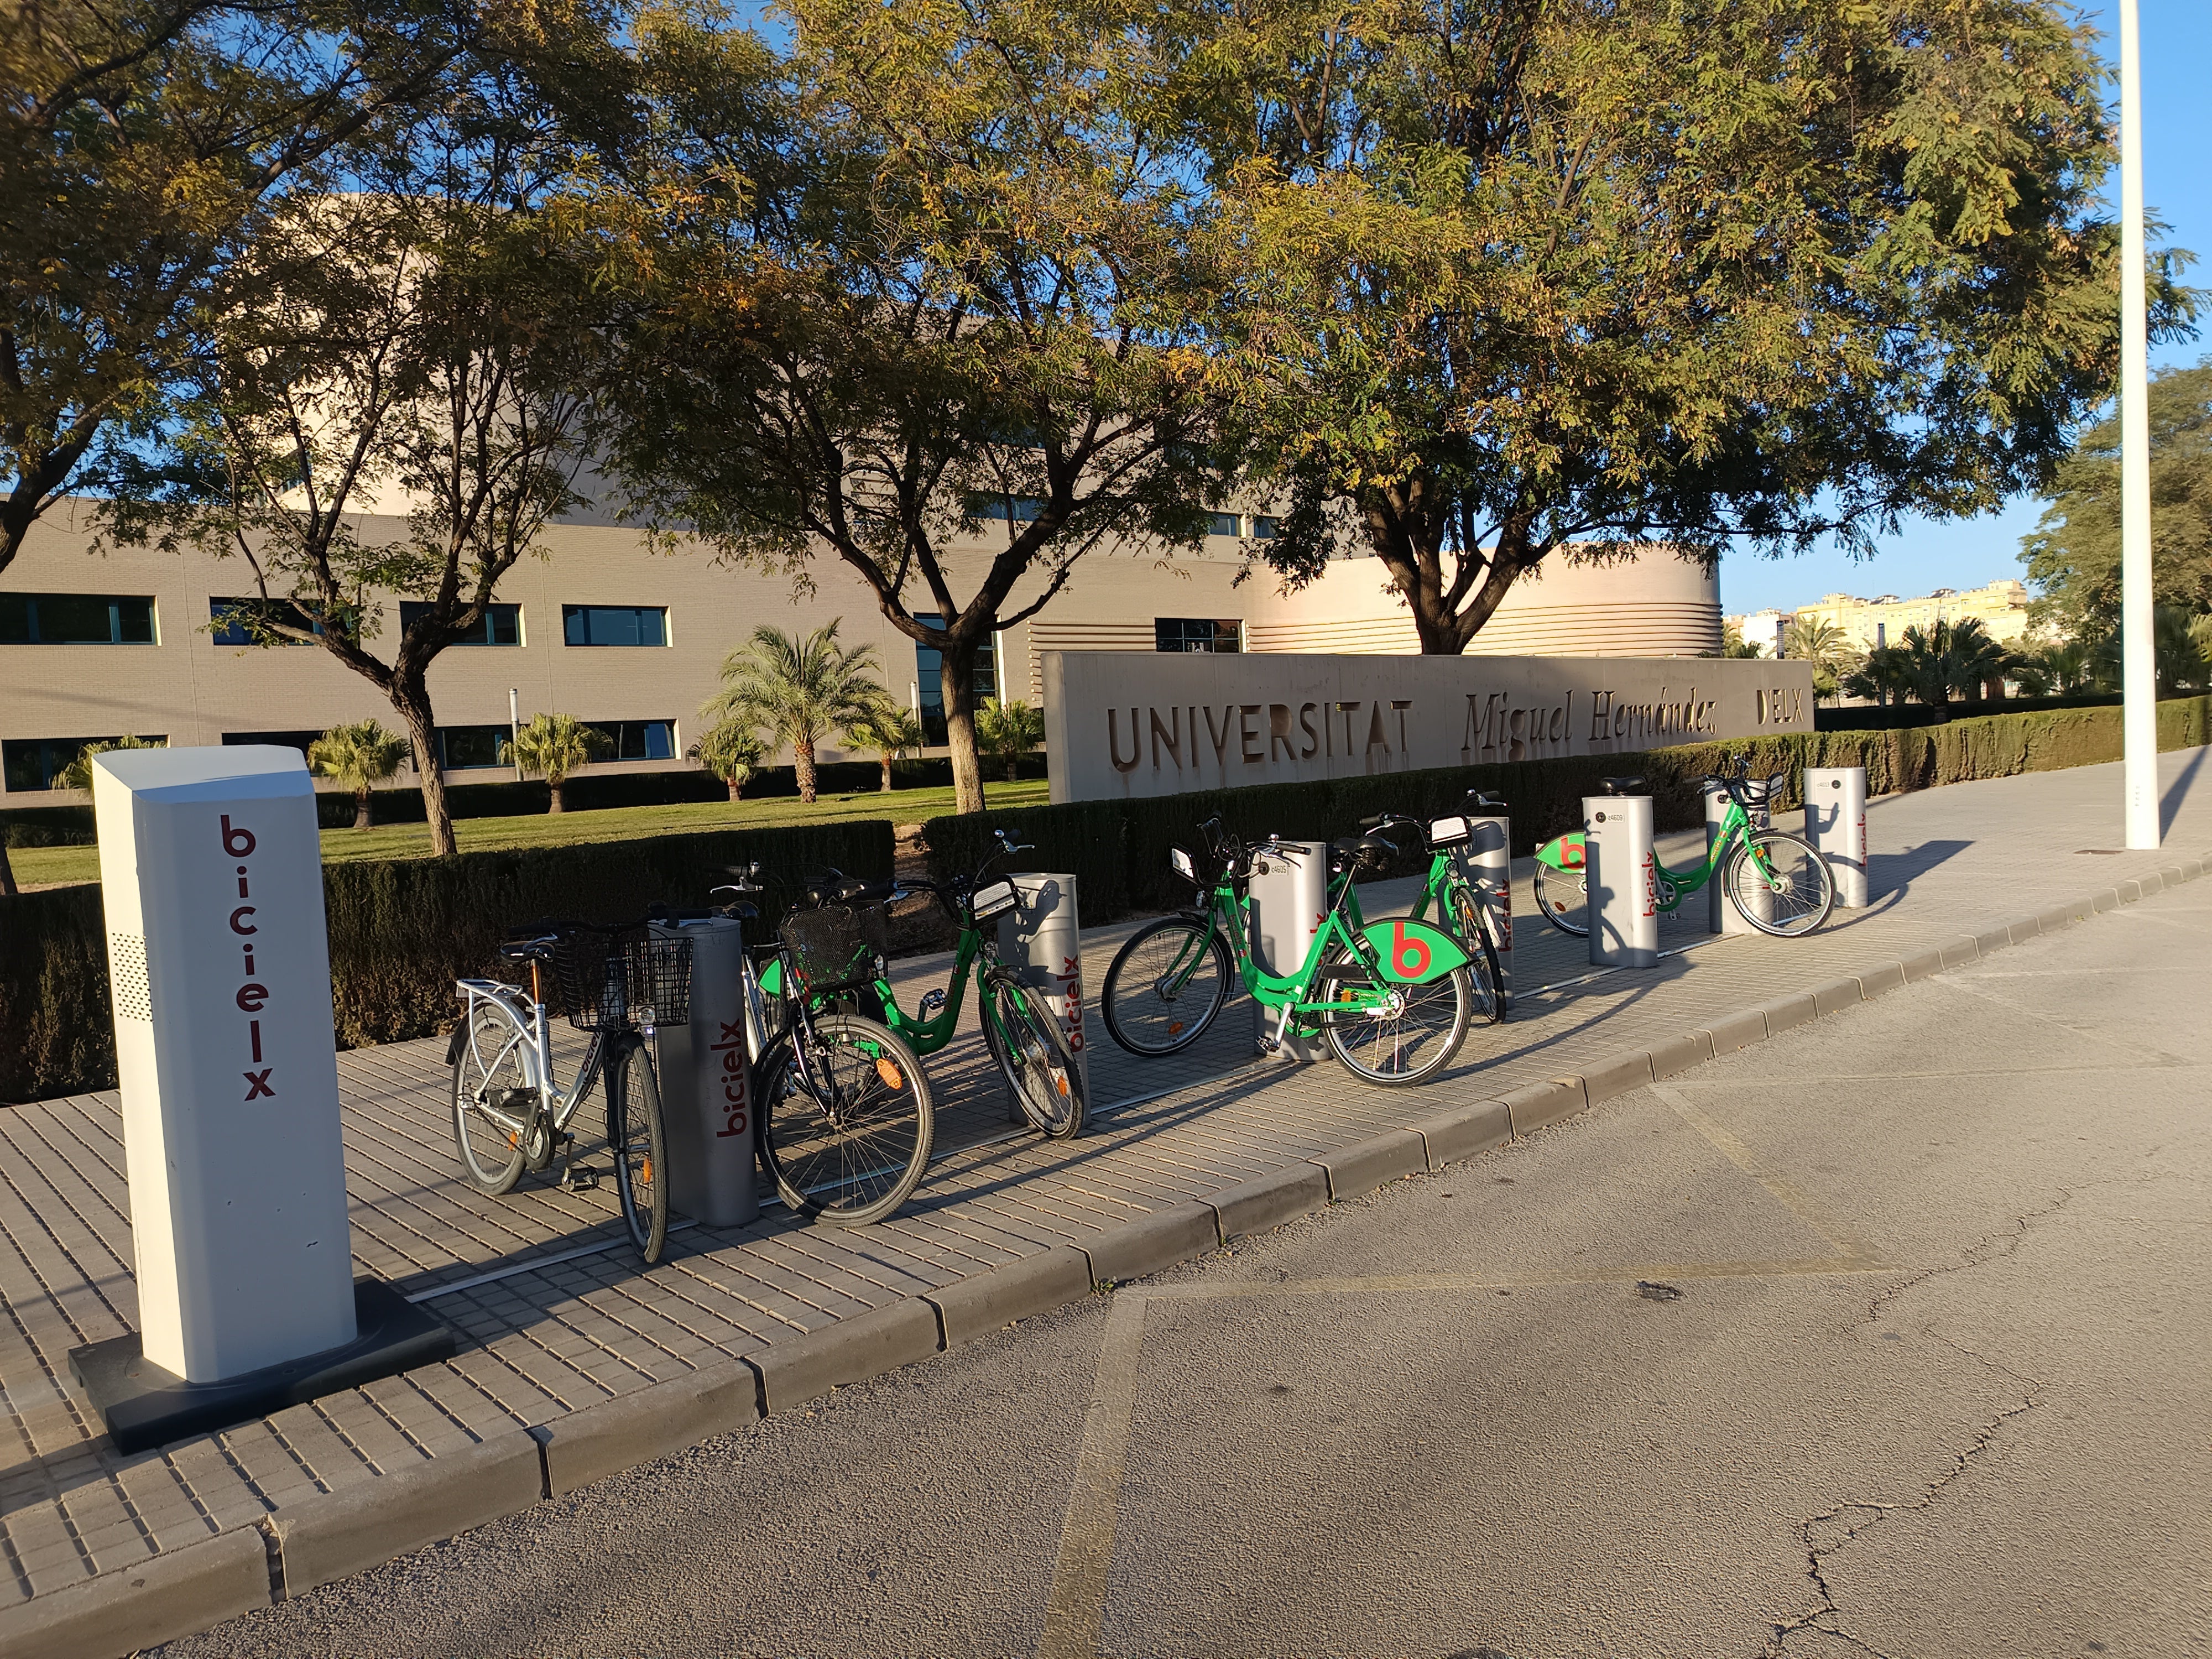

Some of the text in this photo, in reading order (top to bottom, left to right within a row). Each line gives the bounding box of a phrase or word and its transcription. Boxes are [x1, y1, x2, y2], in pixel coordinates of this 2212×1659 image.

[1107, 687, 1804, 773] UNIVERSITAT Miguel Hernández D'ELX
[1561, 837, 1586, 870] b
[221, 815, 276, 1102] bicielx
[1392, 922, 1431, 979] b
[710, 1018, 747, 1138] bicielx
